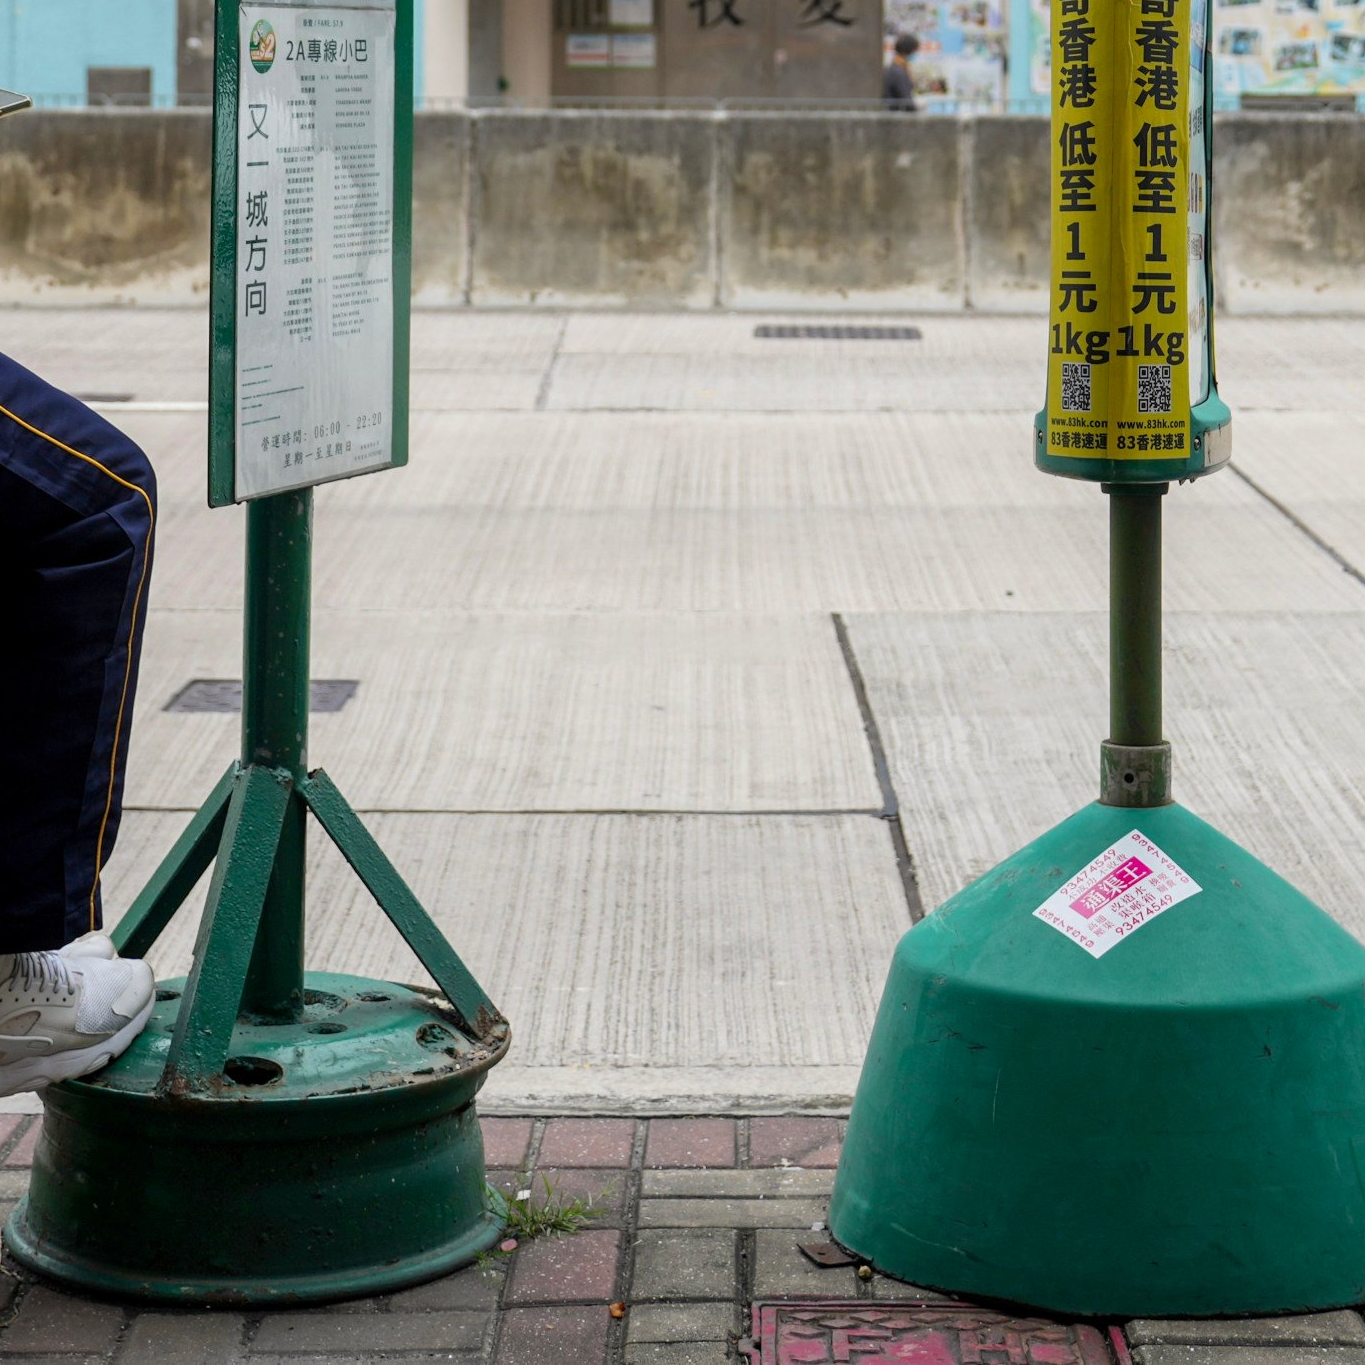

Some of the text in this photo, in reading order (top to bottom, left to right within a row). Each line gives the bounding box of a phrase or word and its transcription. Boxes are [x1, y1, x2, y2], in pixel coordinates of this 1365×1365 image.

[286, 39, 368, 63] 2A專線小巴
[245, 104, 270, 317] 又一城方向
[1058, 121, 1098, 314] 低至1元
[1131, 121, 1178, 315] 低至1元
[1051, 321, 1111, 365] 1kg
[1116, 323, 1185, 366] 1kg
[314, 421, 341, 439] 06:00
[356, 412, 382, 430] 22:20
[1051, 431, 1107, 450] 83香港速運
[1117, 419, 1185, 430] www.83hk.com
[283, 441, 352, 468] 星期一至星期日
[1117, 434, 1184, 451] 83香港速運
[1080, 861, 1147, 913] 通渠王
